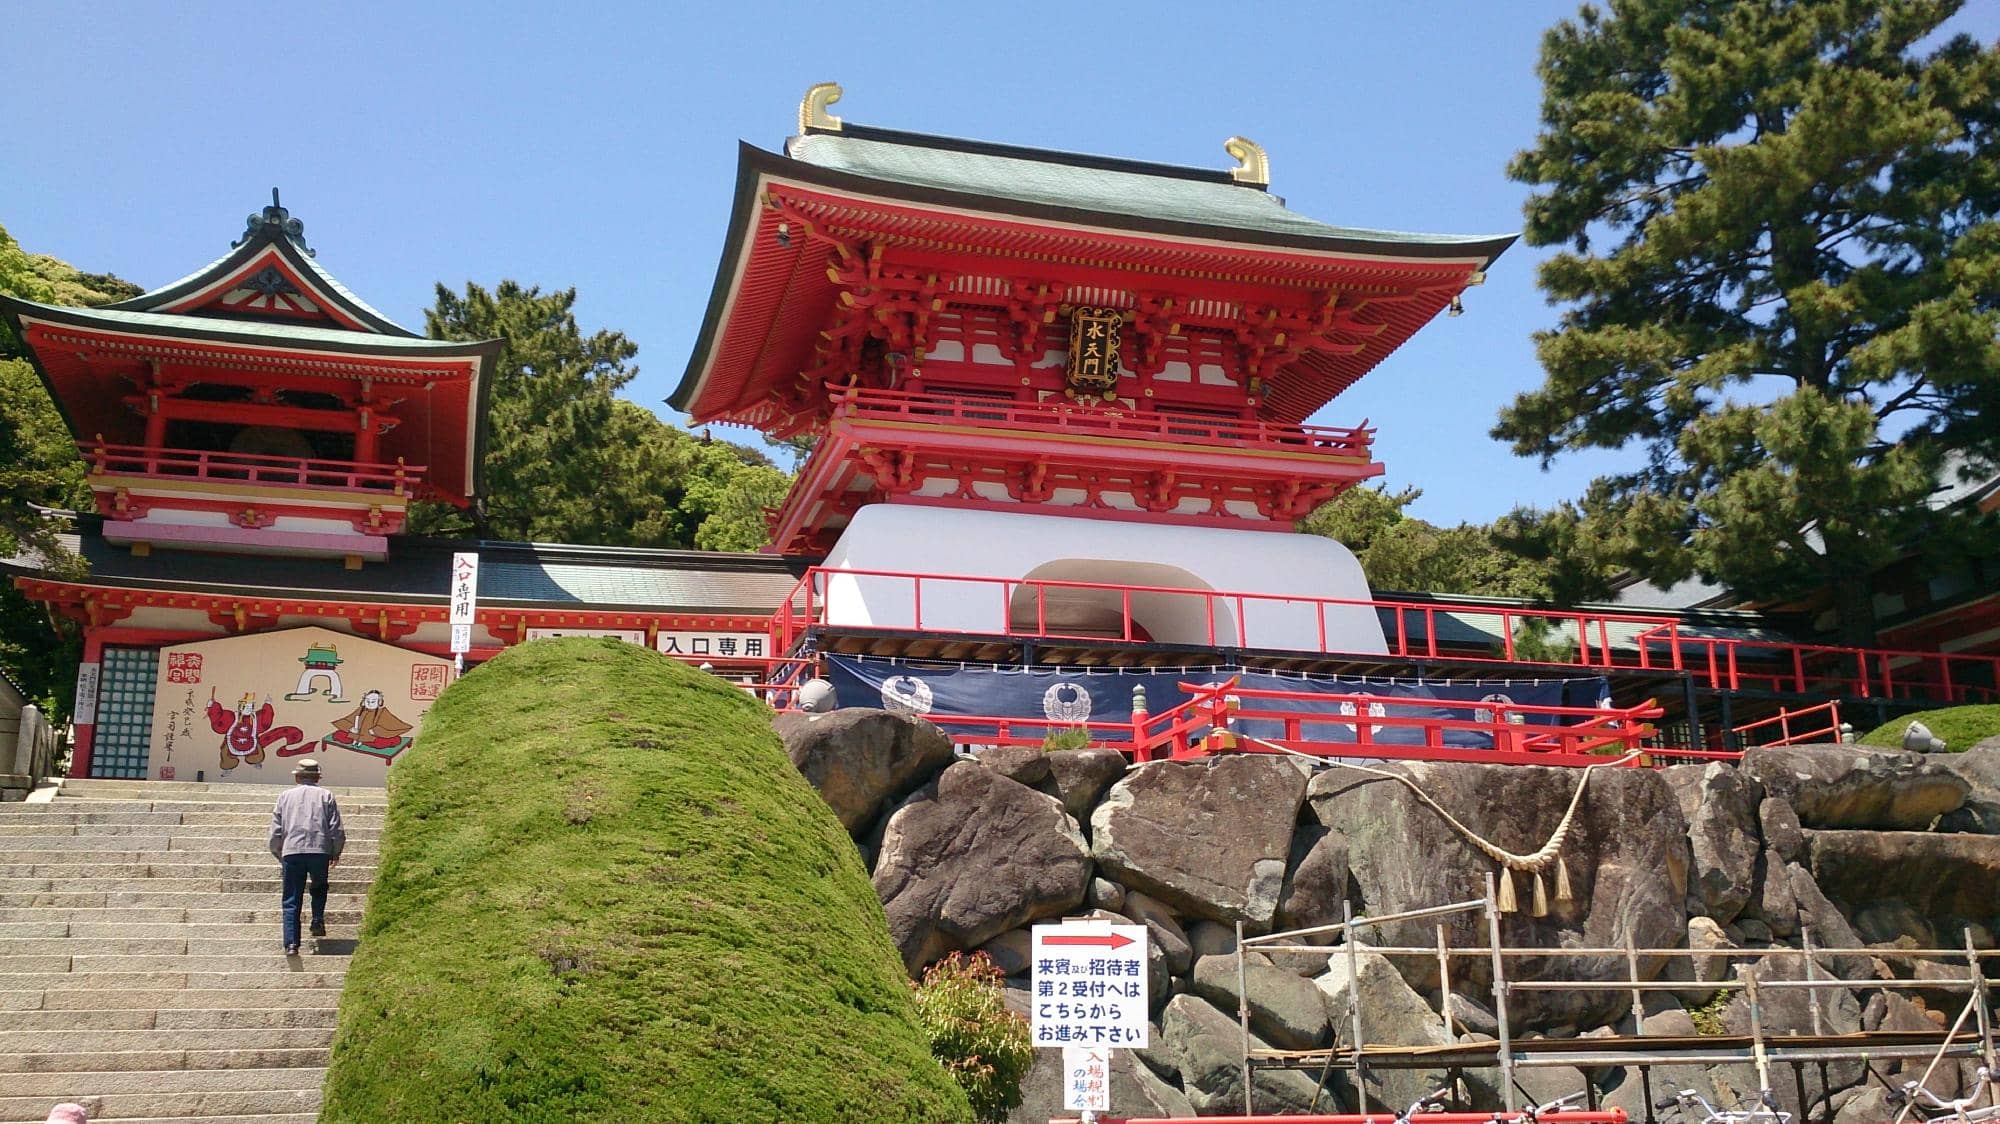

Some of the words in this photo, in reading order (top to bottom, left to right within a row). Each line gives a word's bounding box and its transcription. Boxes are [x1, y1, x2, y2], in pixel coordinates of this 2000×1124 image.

[1083, 321, 1105, 375] 水天門
[455, 556, 475, 618] 入口専用
[664, 636, 763, 657] 入口専用
[1039, 1003, 1122, 1019] こちらから
[1038, 1025, 1141, 1042] お進み下さい
[1072, 1068, 1088, 1108] の場合
